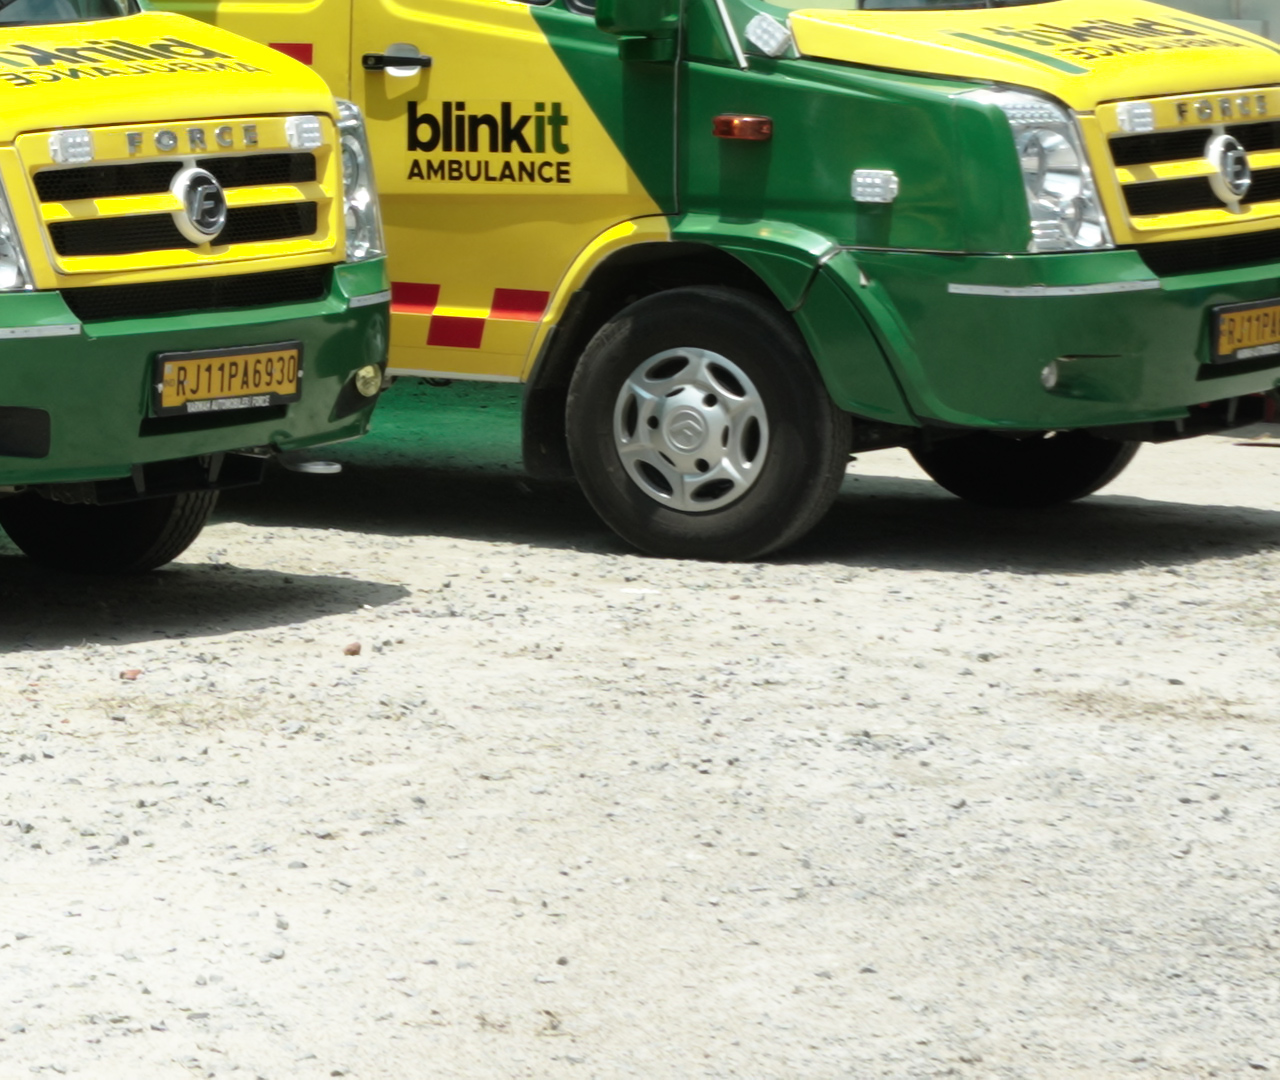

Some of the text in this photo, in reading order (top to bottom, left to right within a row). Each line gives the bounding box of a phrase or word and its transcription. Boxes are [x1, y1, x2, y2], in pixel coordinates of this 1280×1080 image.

[1175, 94, 1268, 121] FORCE
[126, 124, 259, 155] FORCE
[407, 100, 570, 154] blinkit
[407, 158, 571, 183] AMBULANCE
[176, 355, 297, 397] RJ11PA6930
